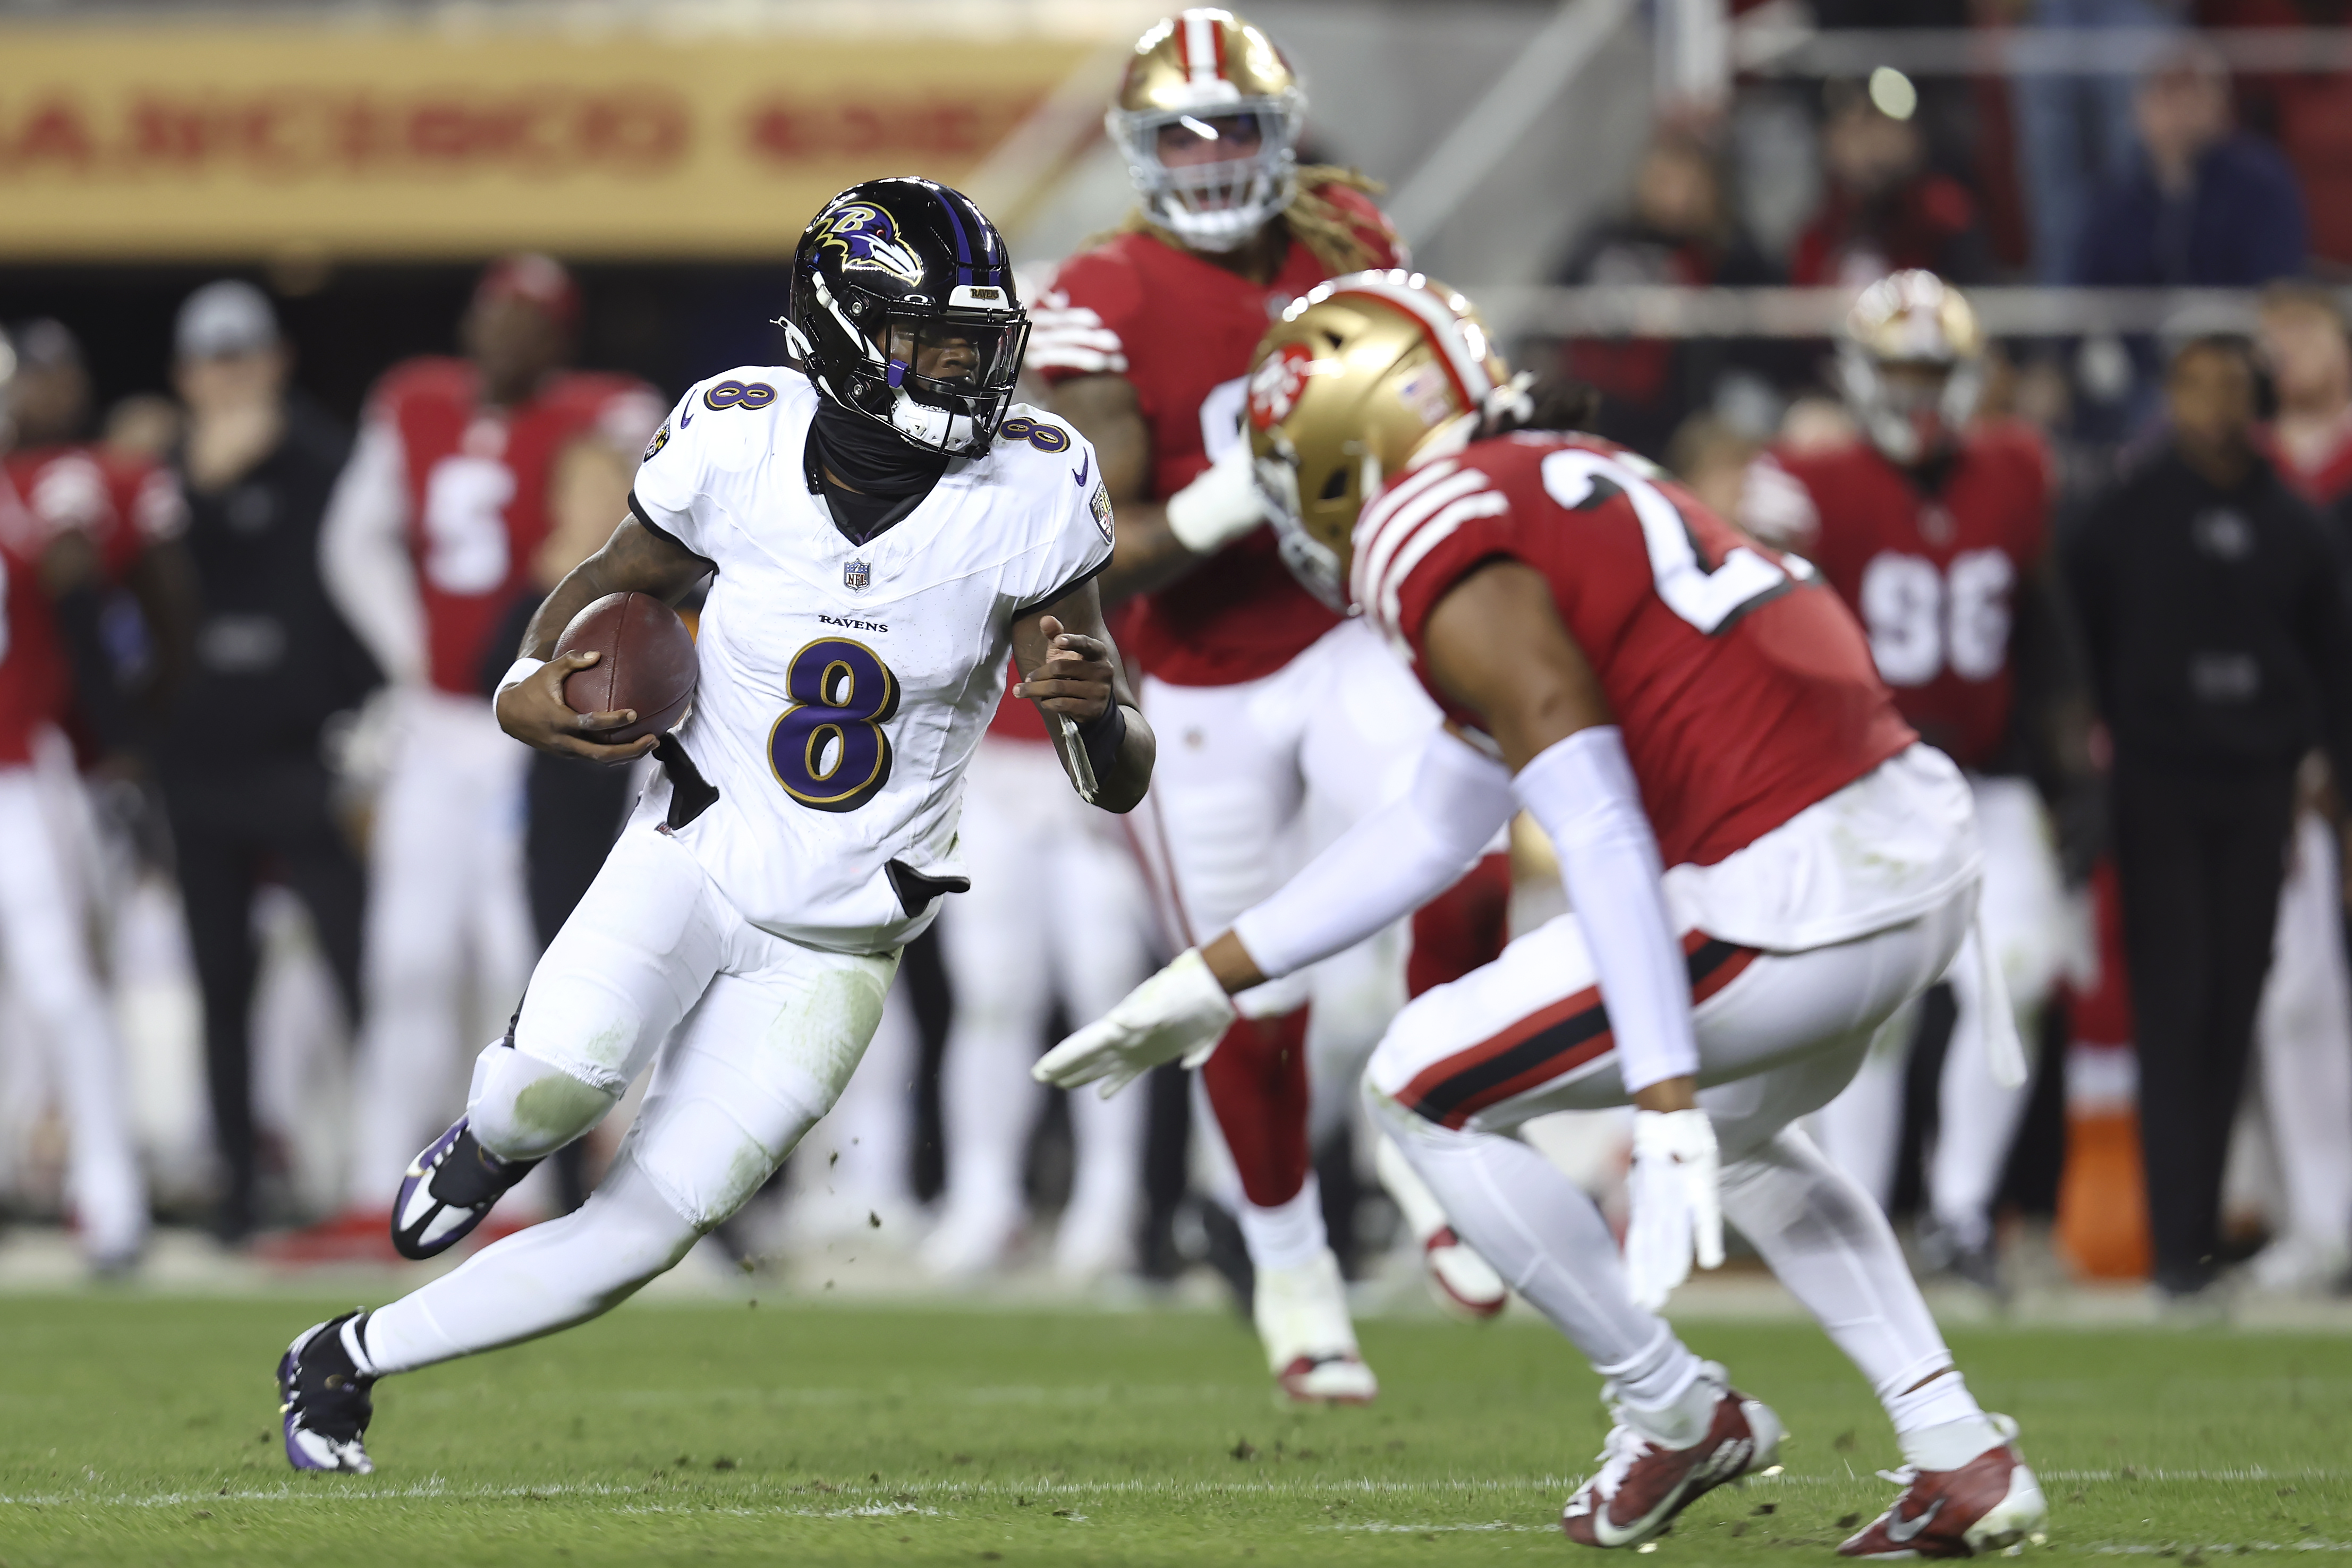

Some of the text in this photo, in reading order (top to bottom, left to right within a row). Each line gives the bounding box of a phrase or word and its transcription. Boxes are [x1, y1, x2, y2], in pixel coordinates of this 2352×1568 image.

[830, 206, 876, 233] B
[969, 288, 999, 301] RAVENS
[703, 379, 778, 411] 8
[998, 416, 1071, 453] 8
[425, 458, 518, 593] 5
[847, 573, 867, 586] NFL
[818, 615, 888, 633] RAVENS
[1861, 548, 2016, 685] 96
[767, 636, 901, 813] 8
